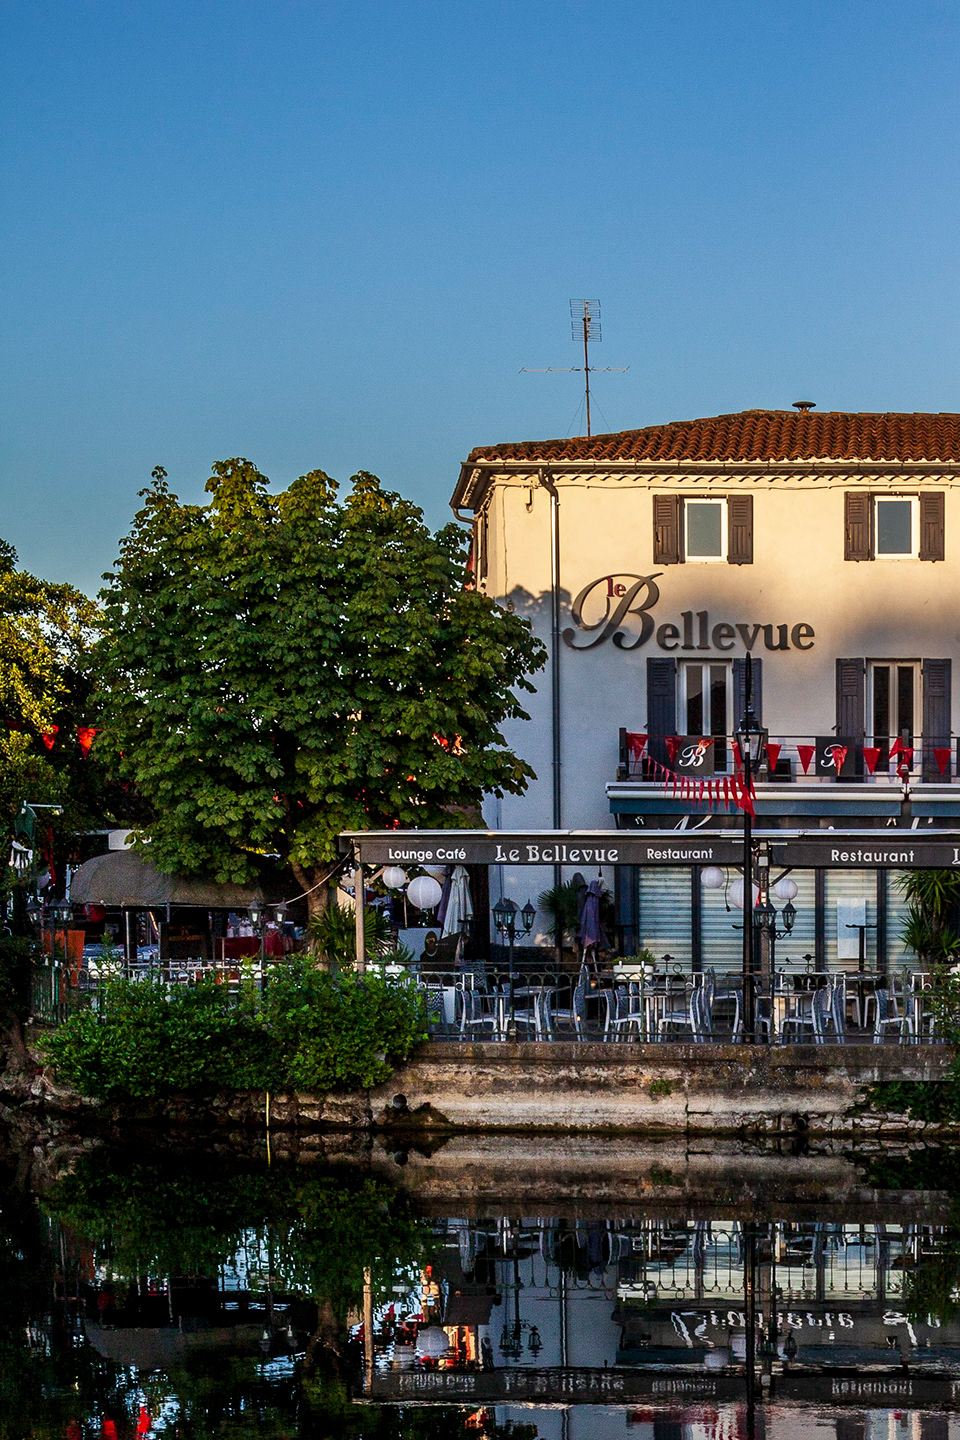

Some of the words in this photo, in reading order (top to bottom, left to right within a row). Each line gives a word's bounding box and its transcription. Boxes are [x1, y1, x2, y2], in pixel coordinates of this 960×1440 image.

[606, 577, 627, 598] le
[562, 572, 815, 651] Bellevue
[388, 848, 433, 863] Lounge
[436, 847, 467, 860] Café
[494, 845, 520, 862] Le
[526, 845, 619, 862] Bellevue
[646, 848, 714, 860] Restaurant
[831, 849, 915, 863] Restaurant
